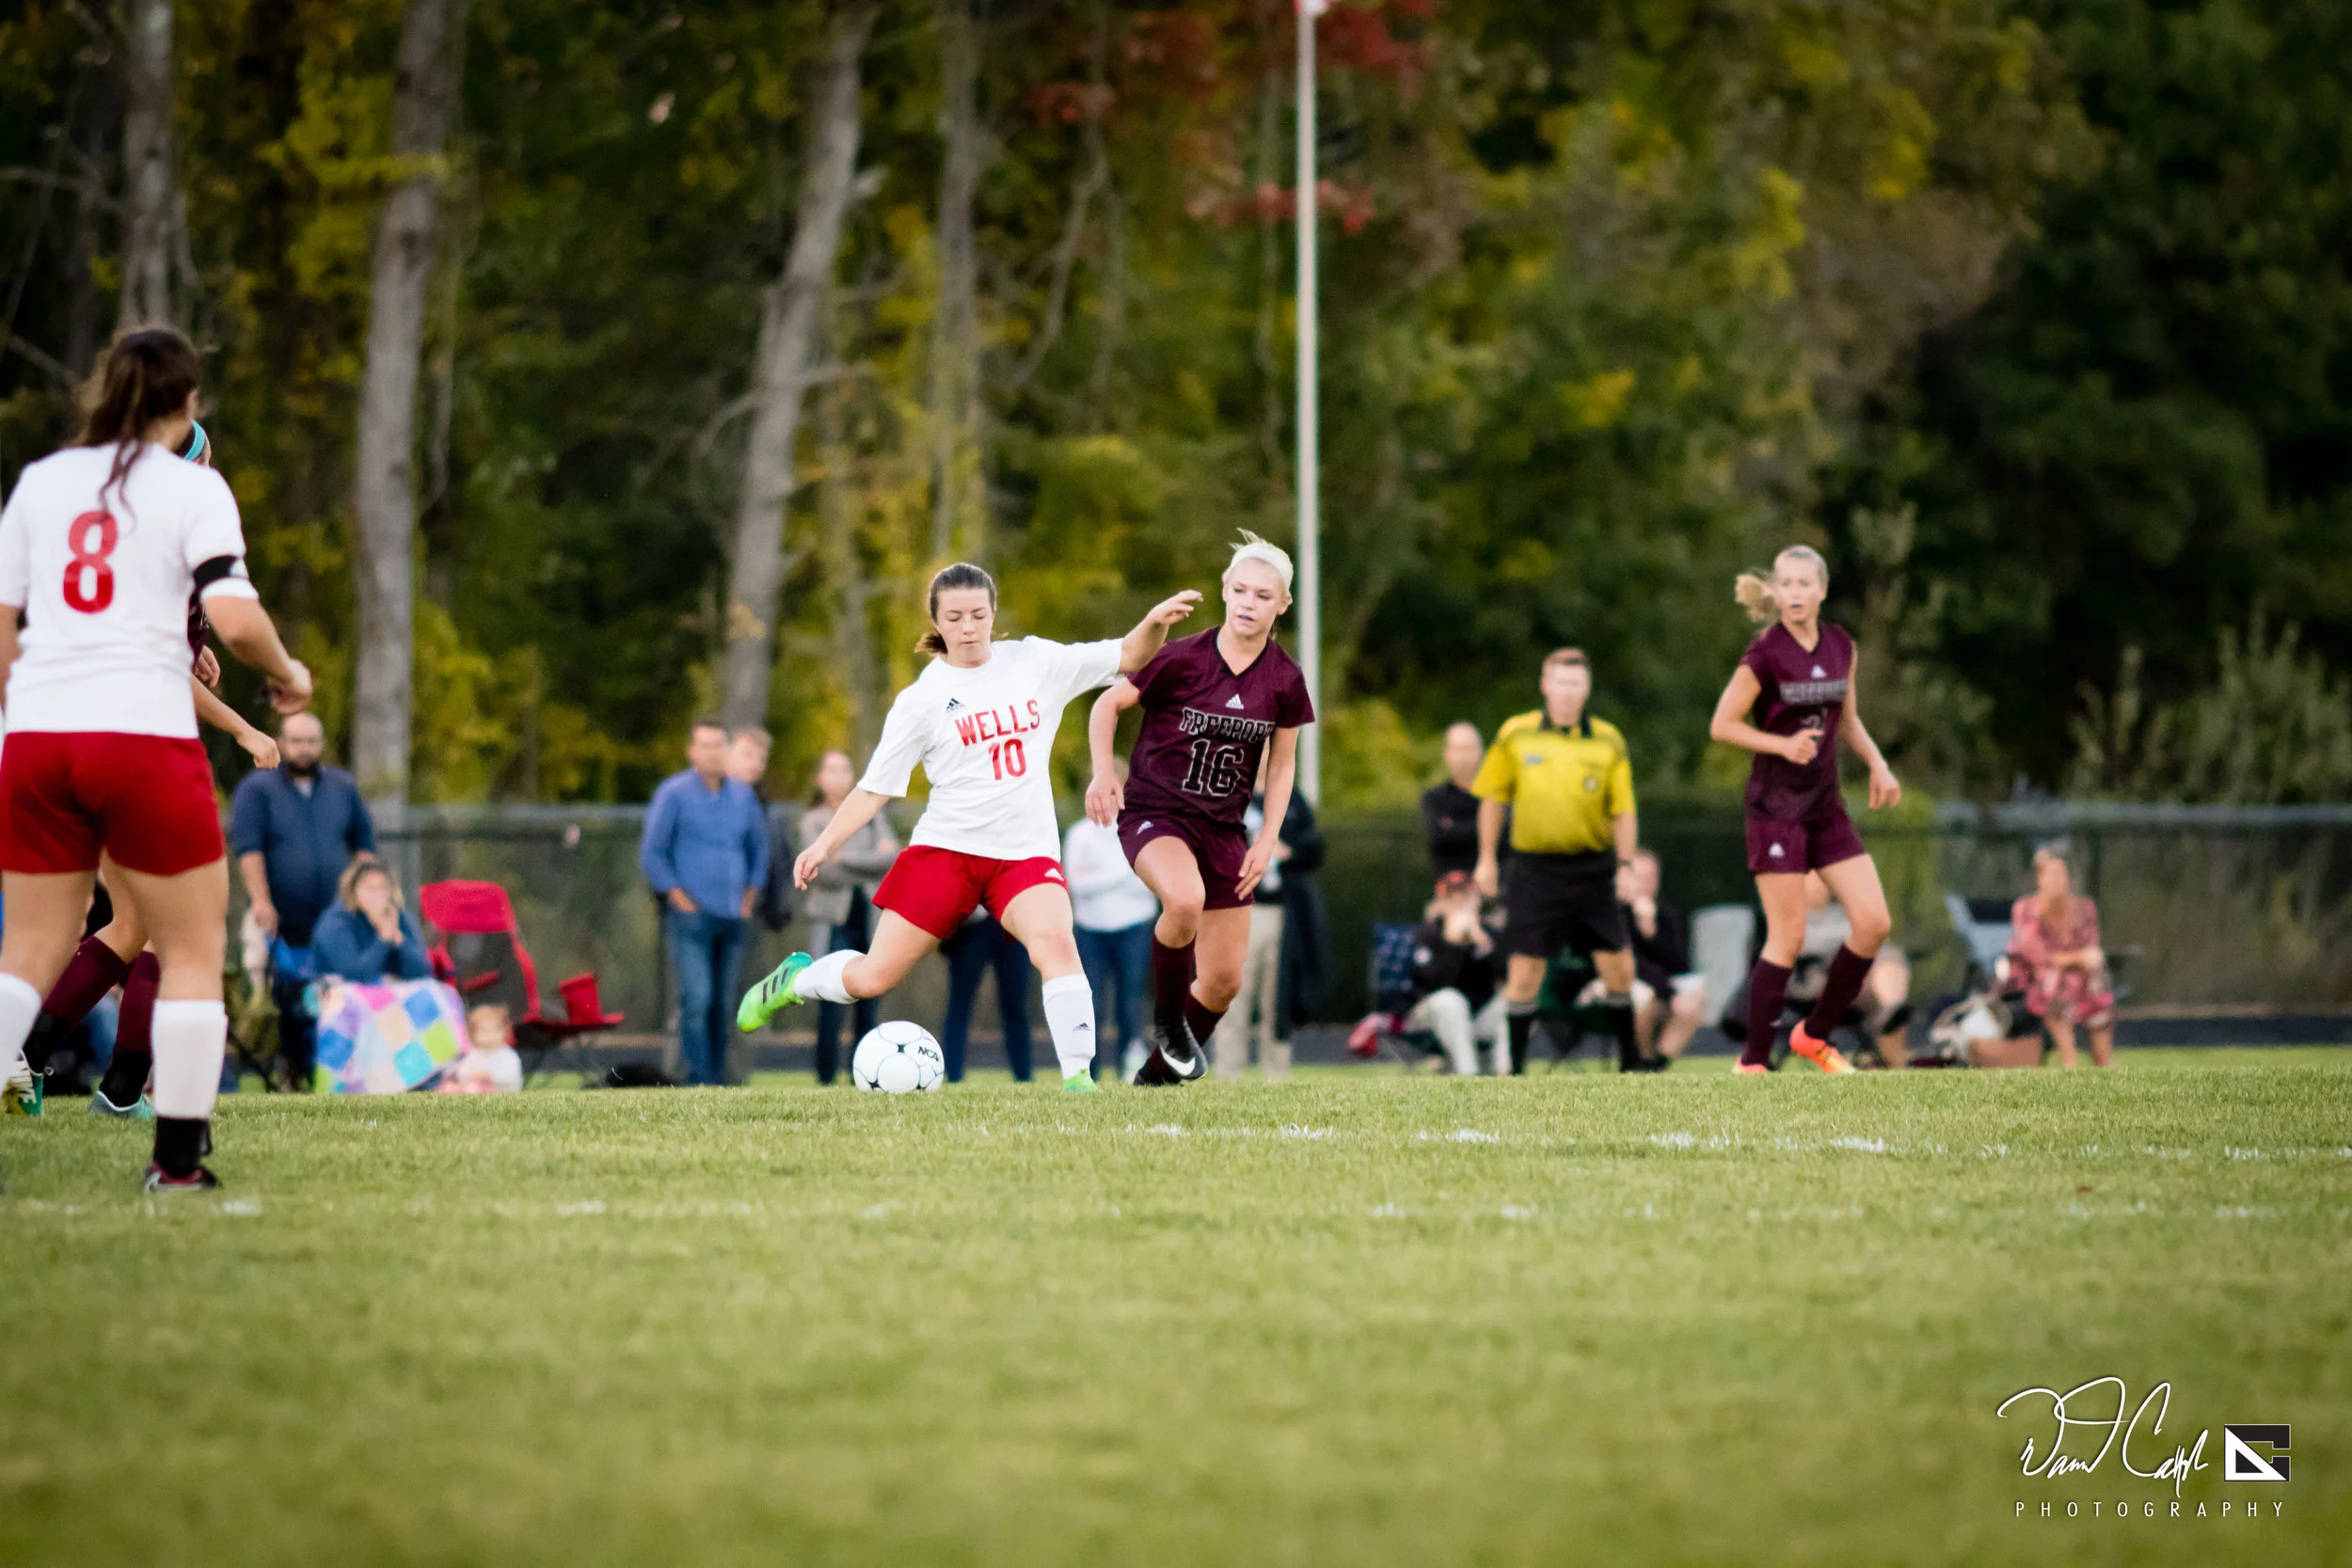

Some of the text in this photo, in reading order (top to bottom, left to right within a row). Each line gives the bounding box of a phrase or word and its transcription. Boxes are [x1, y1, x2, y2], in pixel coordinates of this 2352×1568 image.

[62, 511, 119, 614] 8
[954, 699, 1041, 747] WELLS
[988, 738, 1026, 781] 10
[1182, 738, 1244, 797] 16
